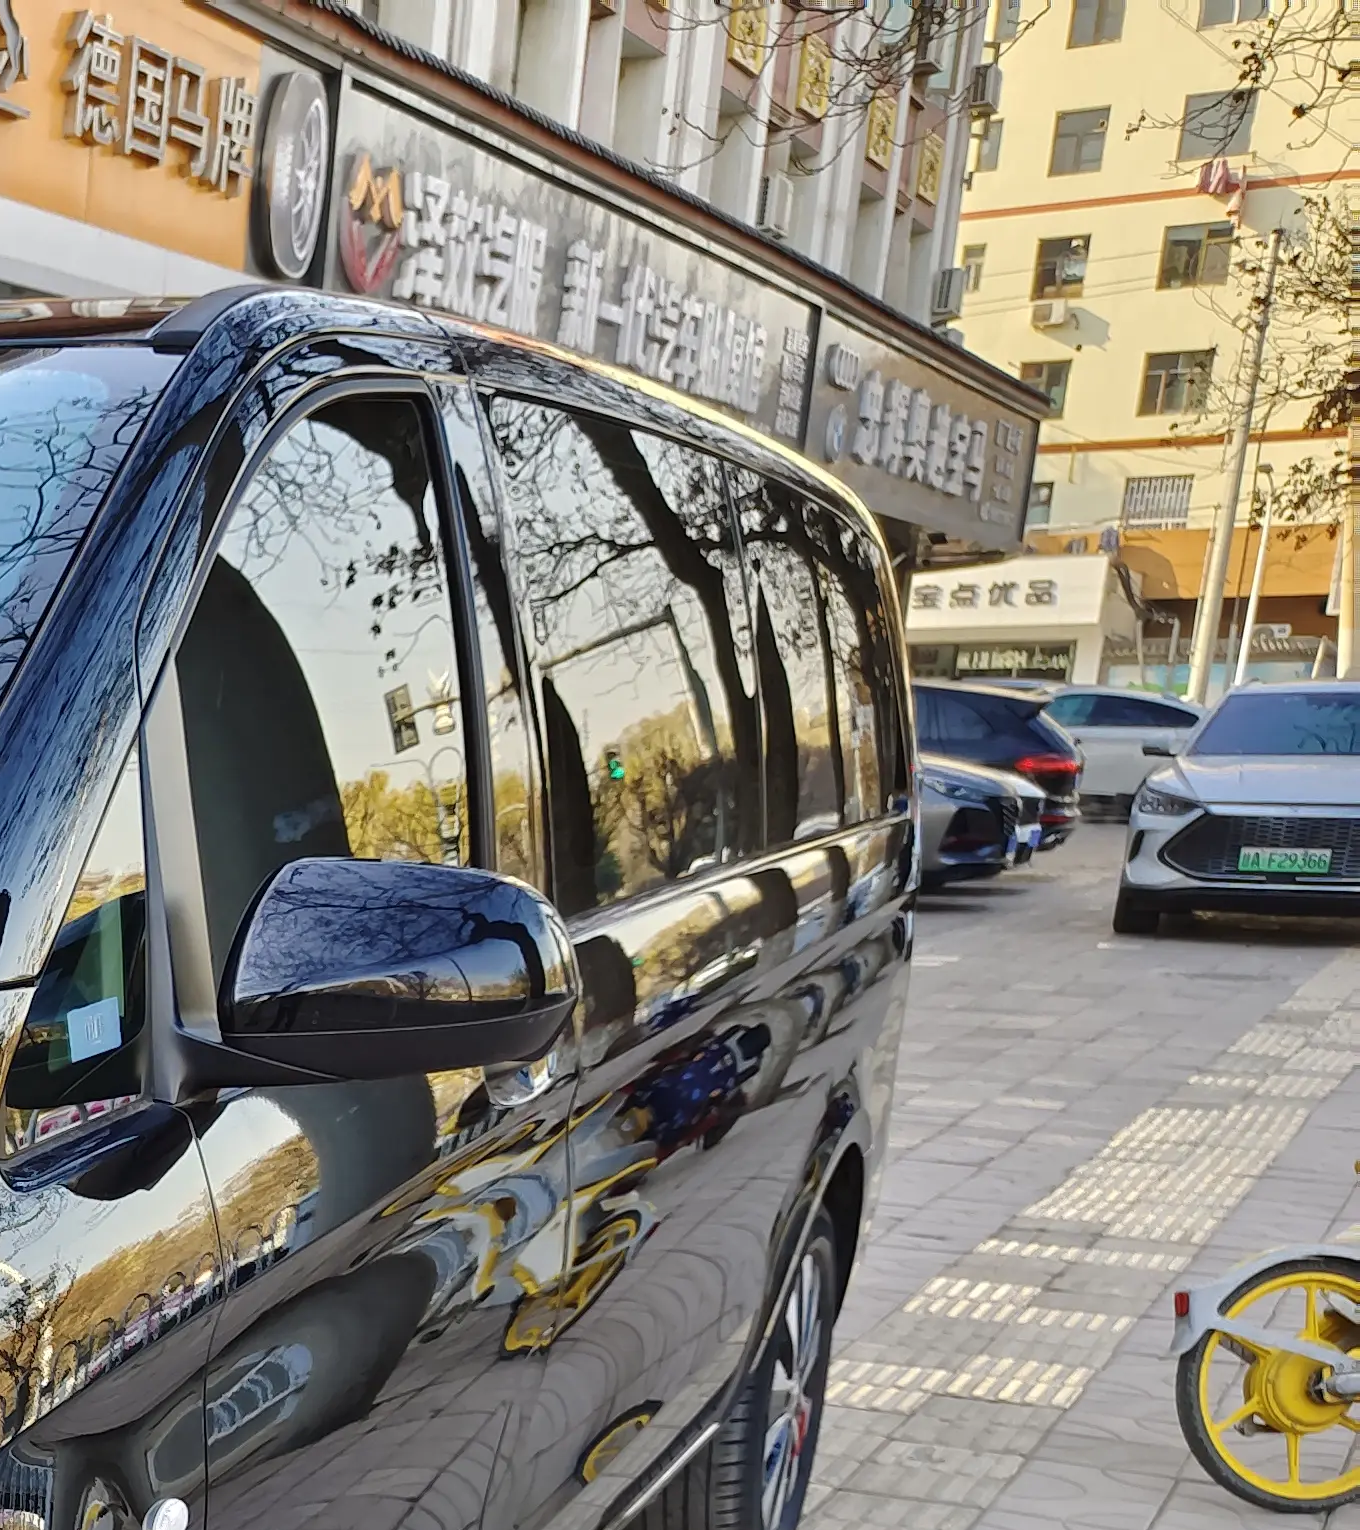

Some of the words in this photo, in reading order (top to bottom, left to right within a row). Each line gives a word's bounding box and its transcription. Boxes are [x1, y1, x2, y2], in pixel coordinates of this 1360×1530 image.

[65, 10, 254, 196] 德国马牌
[912, 580, 1057, 610] 宝点优品
